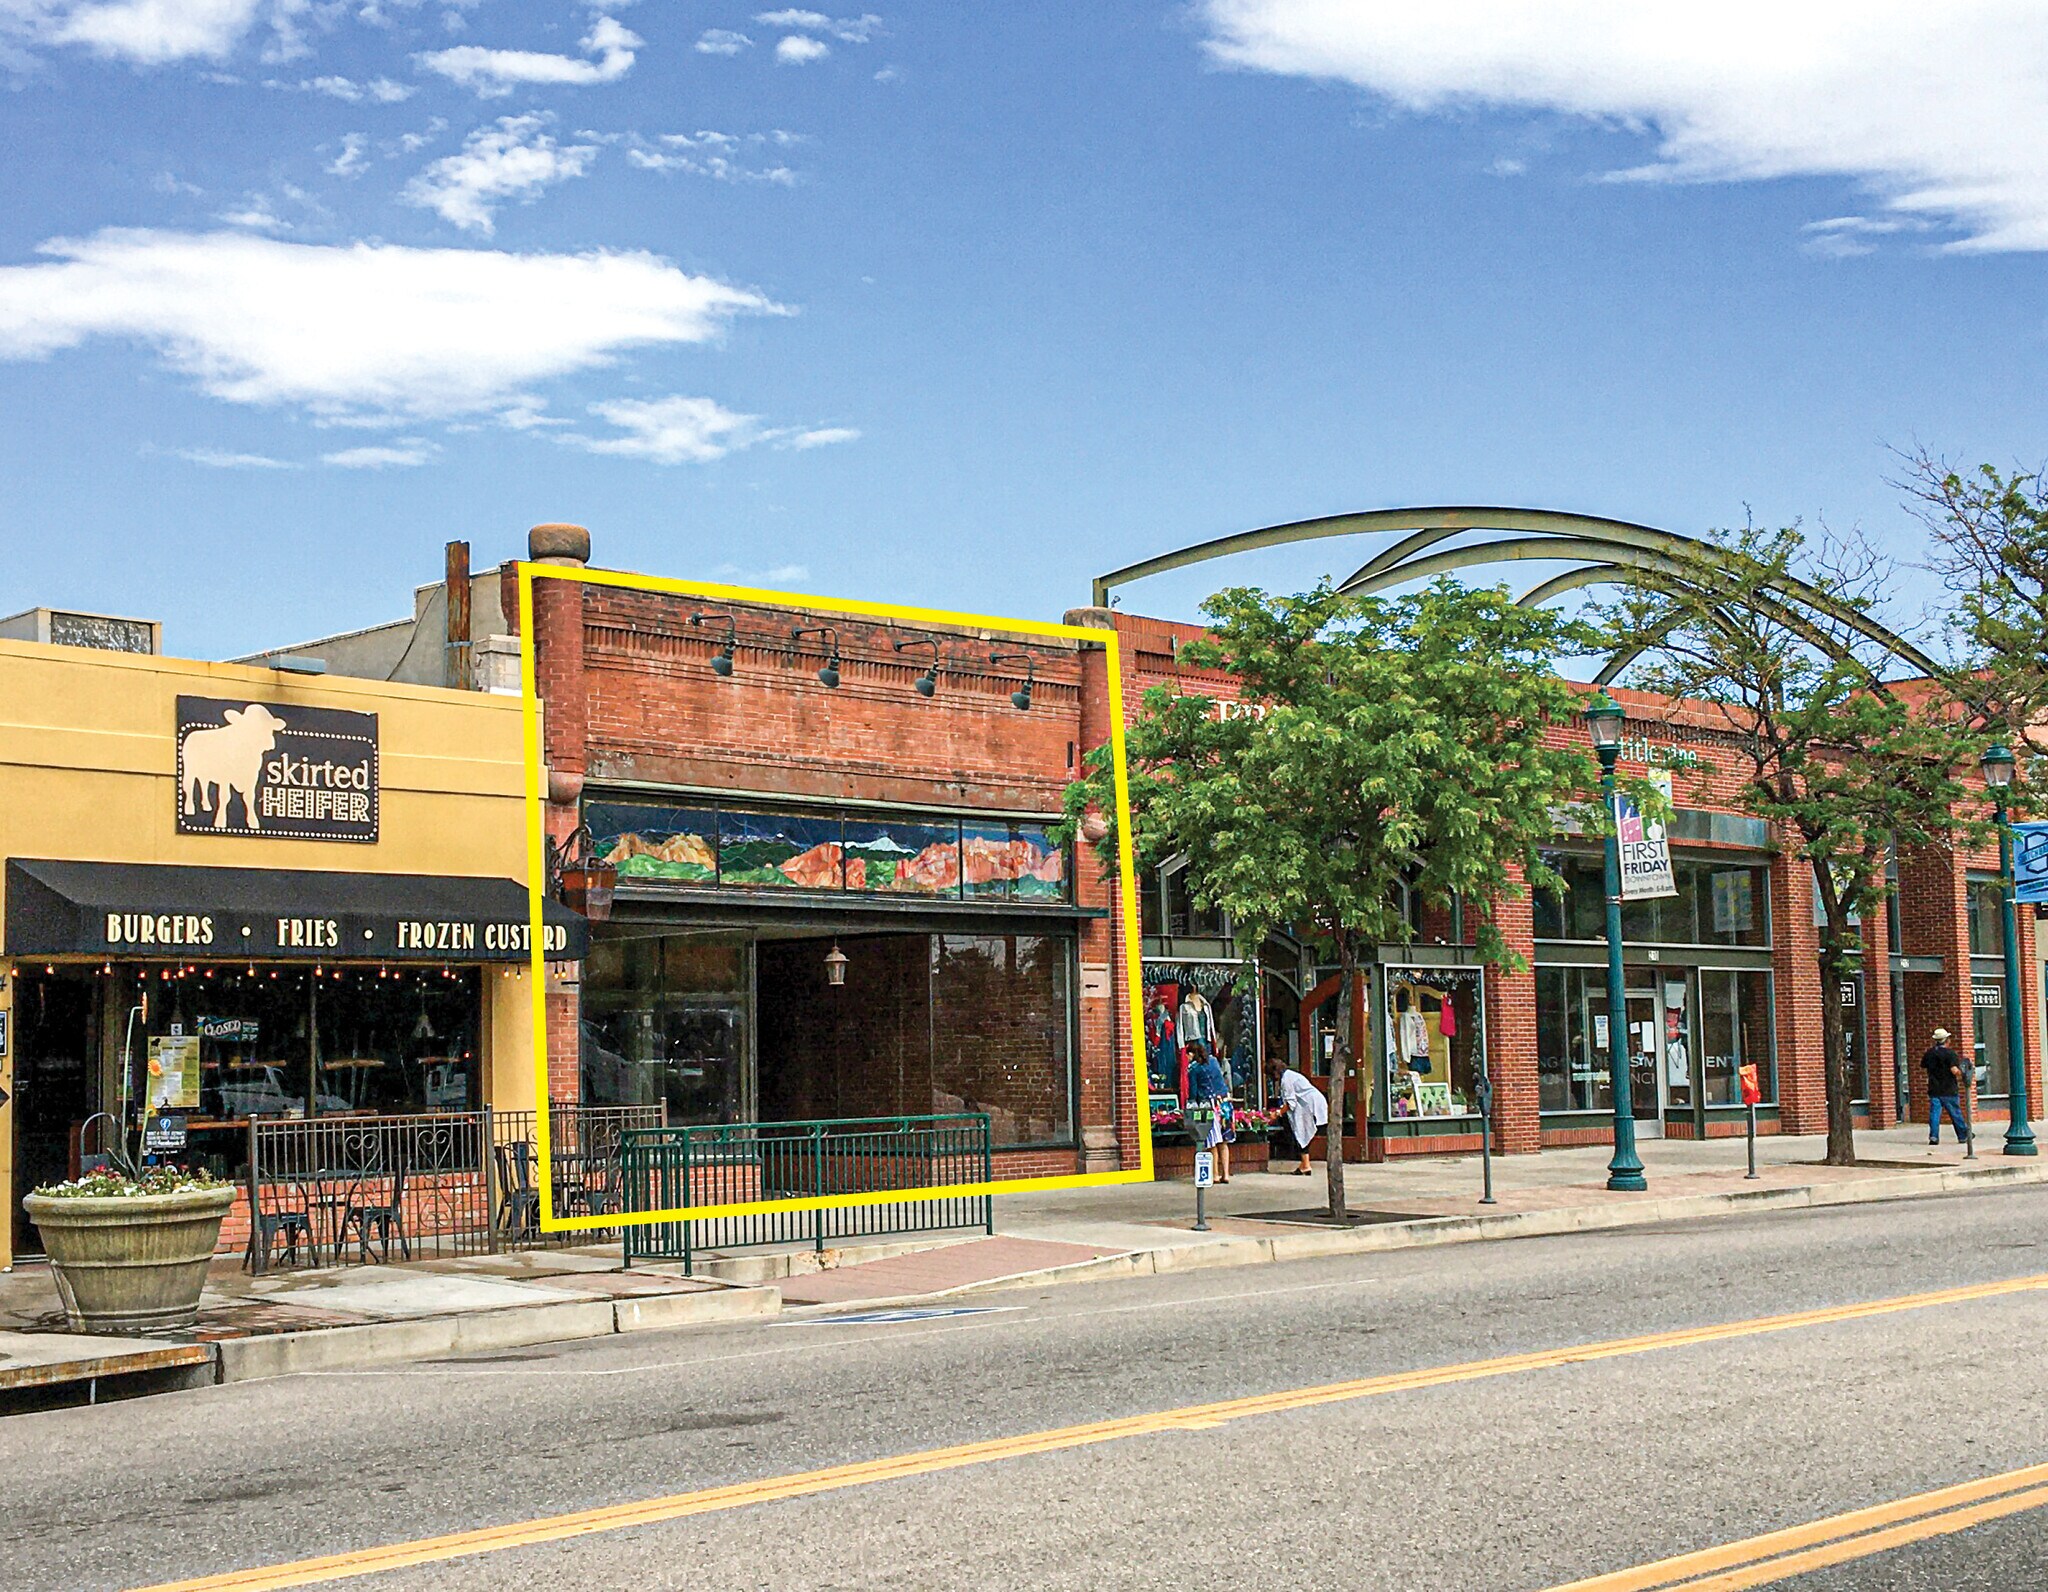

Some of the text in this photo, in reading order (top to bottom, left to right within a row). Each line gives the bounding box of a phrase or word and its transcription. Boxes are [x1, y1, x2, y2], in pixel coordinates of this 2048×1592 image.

[267, 752, 371, 791] skirted
[262, 786, 371, 823] HEIFER
[1623, 840, 1665, 861] FIRST
[1624, 860, 1669, 876] FRIDAY
[106, 913, 567, 951] BURGERS FRIES FROZEN CUSTRD
